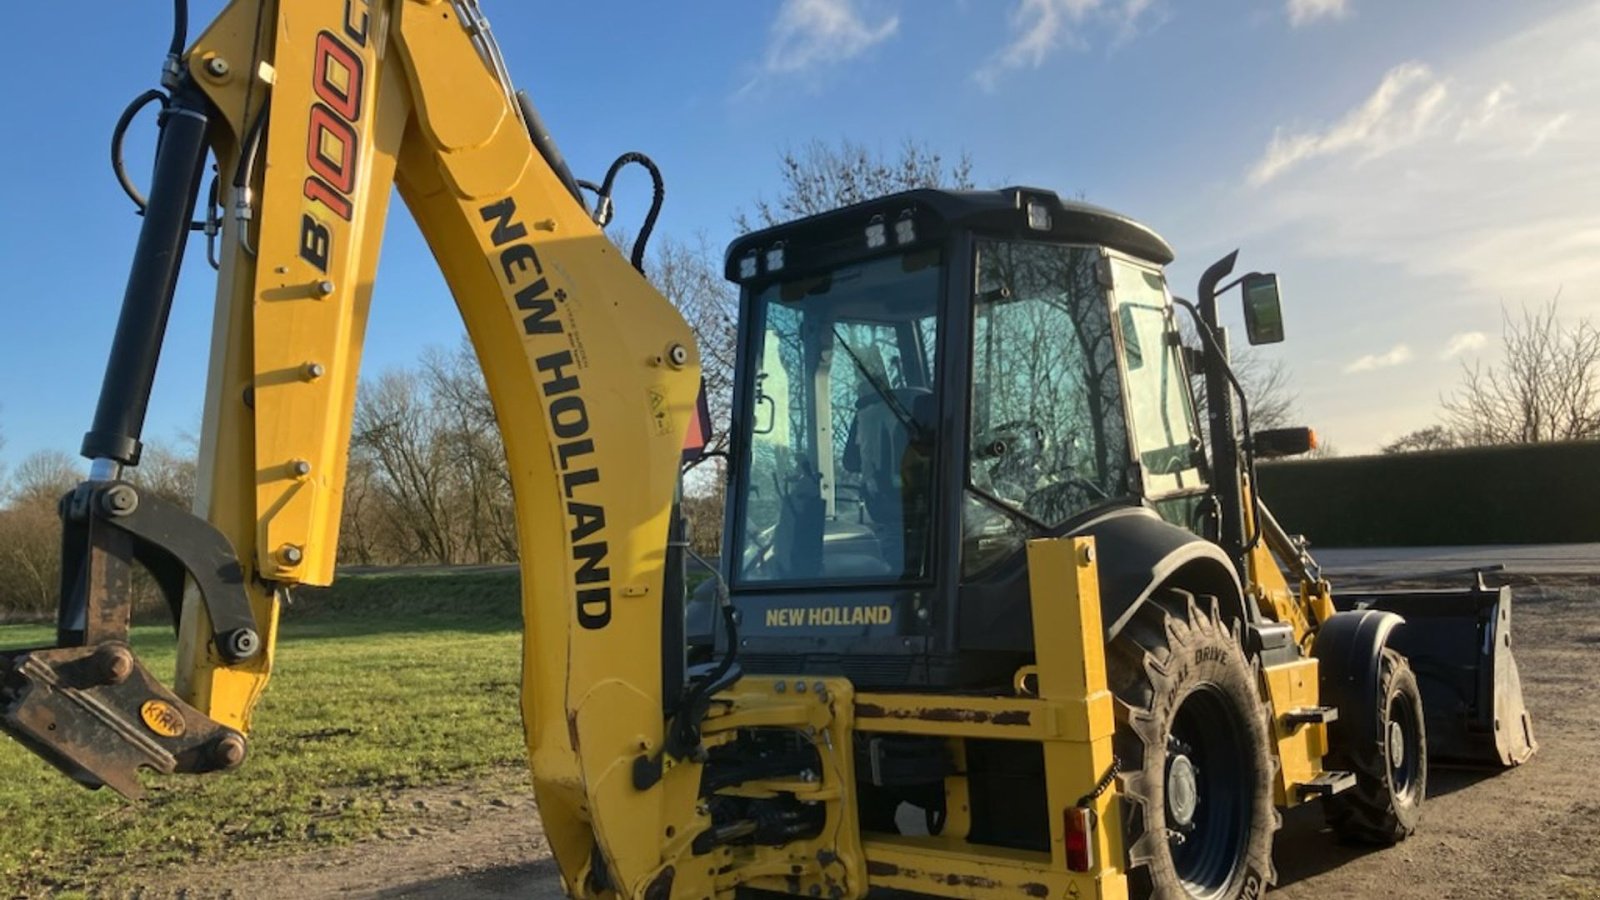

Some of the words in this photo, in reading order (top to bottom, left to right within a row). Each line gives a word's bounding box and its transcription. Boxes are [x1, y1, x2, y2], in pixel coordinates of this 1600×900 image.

[478, 196, 564, 336] NEW
[534, 350, 612, 630] HOLLAND
[765, 607, 806, 627] NEW
[808, 605, 892, 626] HOLLAND
[1194, 645, 1229, 666] DRIVE
